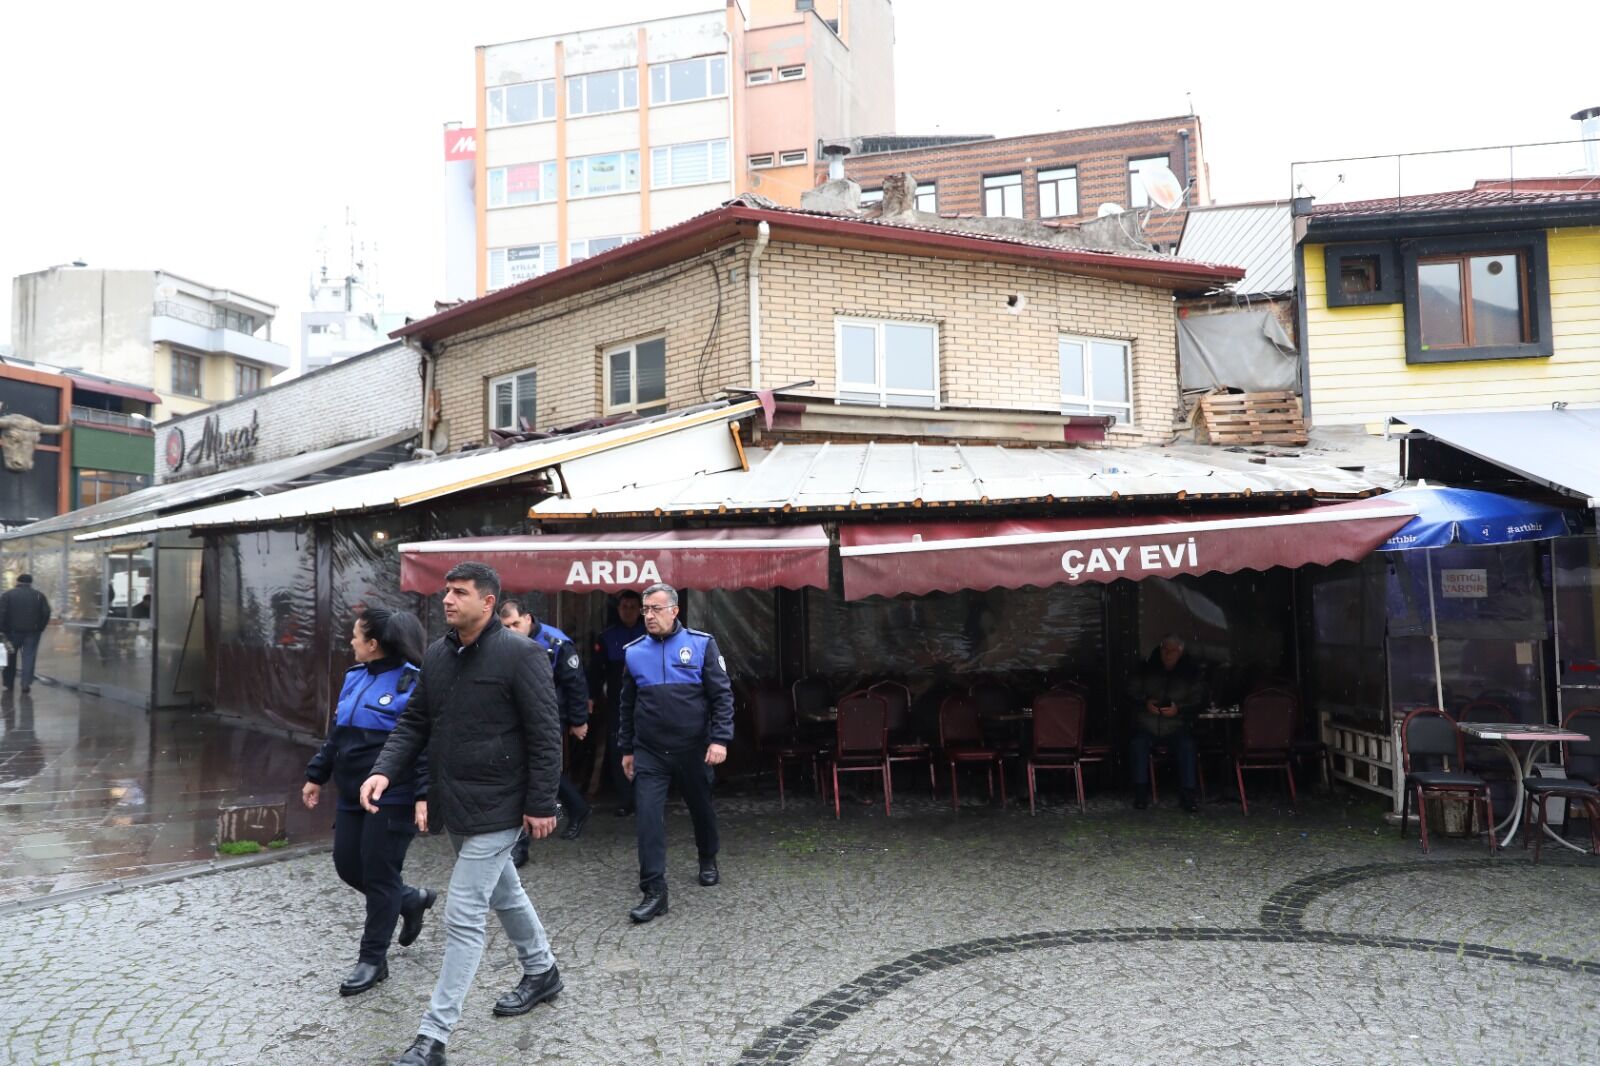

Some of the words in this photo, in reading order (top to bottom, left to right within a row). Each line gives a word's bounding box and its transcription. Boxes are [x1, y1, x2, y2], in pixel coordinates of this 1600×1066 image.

[565, 559, 663, 585] ARDA
[1061, 546, 1131, 580] ÇAY
[1139, 537, 1198, 570] EVİ
